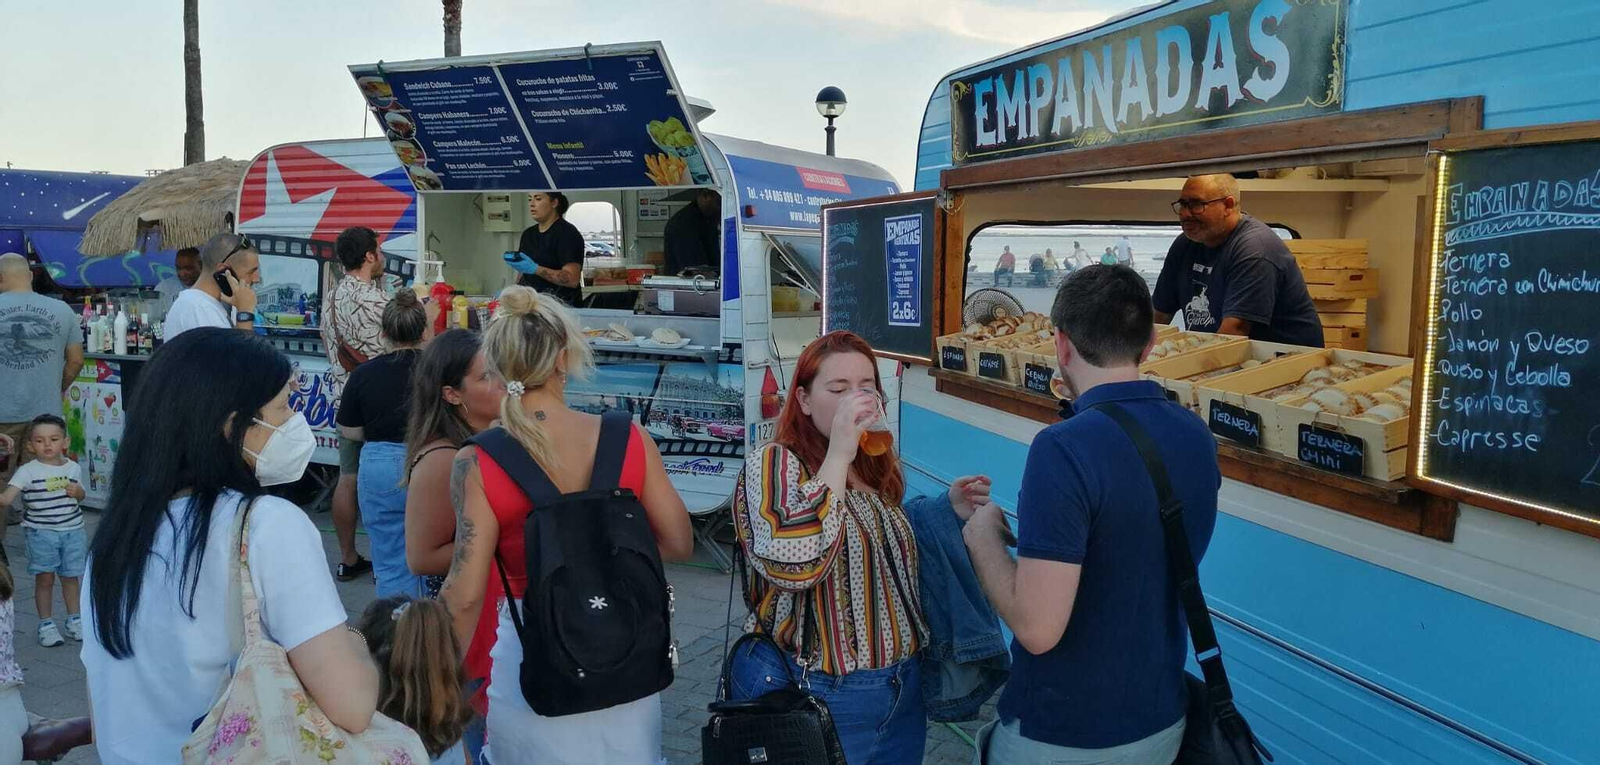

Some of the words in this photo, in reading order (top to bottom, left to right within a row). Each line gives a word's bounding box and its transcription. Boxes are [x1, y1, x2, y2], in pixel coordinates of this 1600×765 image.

[974, 0, 1295, 147] EMPANADAS
[1510, 340, 1520, 371] y
[1488, 369, 1498, 398] y
[1505, 361, 1571, 387] Cebolla
[1212, 407, 1259, 437] TERNERA
[1301, 431, 1363, 456] TERNERA
